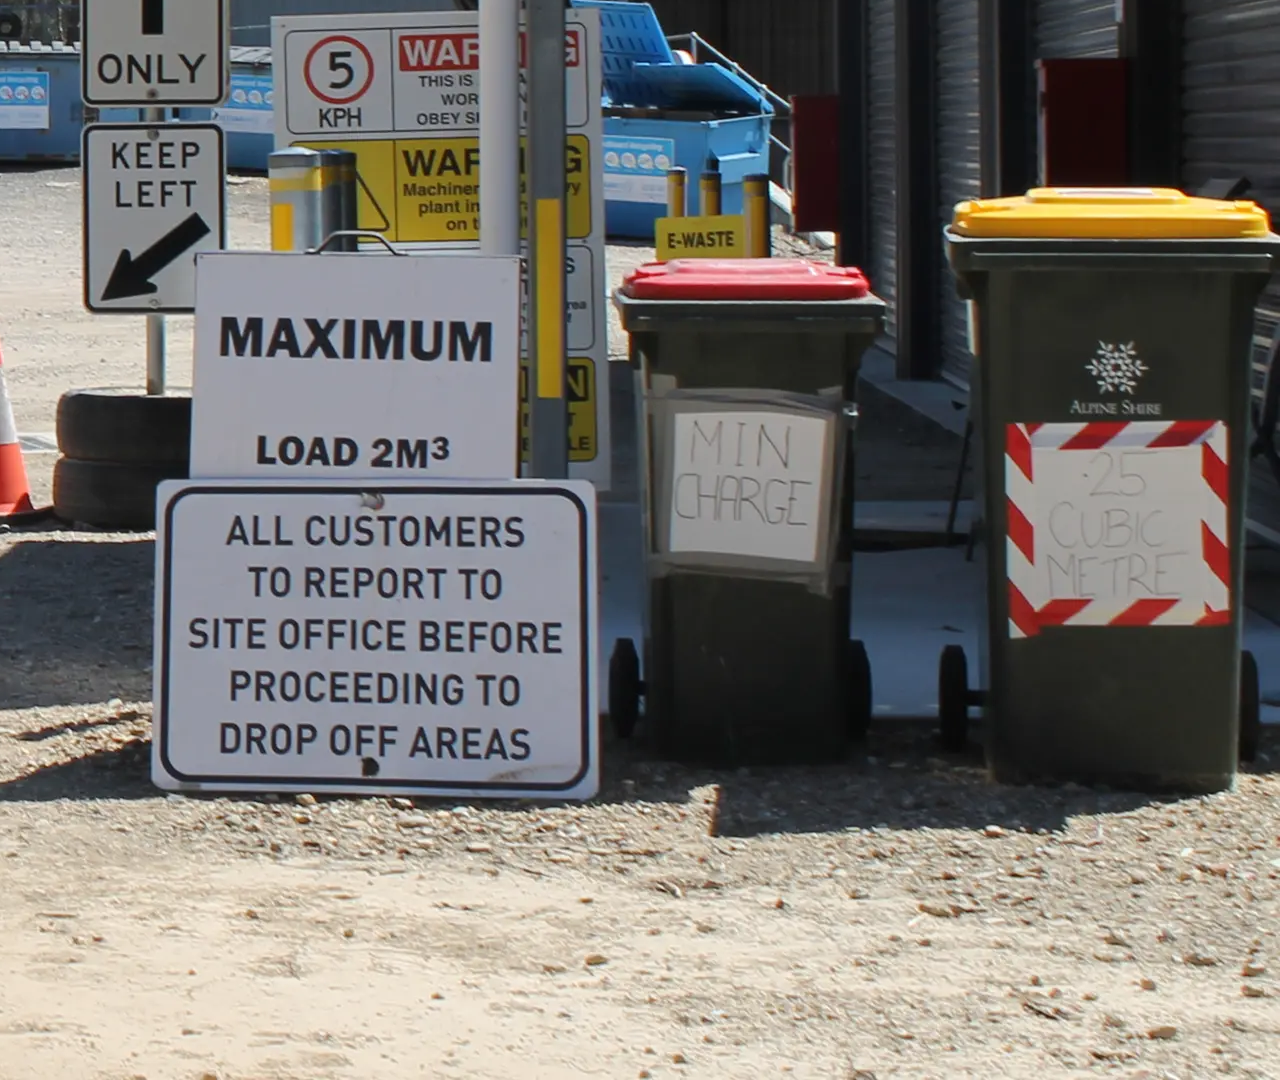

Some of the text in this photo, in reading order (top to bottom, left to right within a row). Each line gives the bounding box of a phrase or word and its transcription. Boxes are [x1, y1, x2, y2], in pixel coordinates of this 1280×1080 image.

[97, 53, 207, 84] ONLY
[329, 51, 354, 89] 5
[418, 73, 474, 87] THIS IS
[319, 108, 362, 127] KPH
[416, 112, 460, 125] OBEY
[112, 142, 200, 169] KEEP
[115, 181, 198, 207] LEFT
[403, 182, 480, 196] Machiner
[418, 200, 460, 217] plant
[446, 220, 467, 230] on
[667, 230, 735, 249] E-WASTE
[220, 317, 492, 362] MAXIMUM
[257, 435, 359, 466] LOAD
[691, 420, 790, 469] MIN
[674, 473, 812, 526] CHARGE
[226, 515, 525, 548] ALL CUSTOMERS
[1048, 501, 1164, 549] CUBIC
[248, 567, 502, 600] TO REPORT TO
[1046, 552, 1190, 598] METRE
[188, 618, 563, 653] SITE OFFICE BEFORE
[230, 671, 521, 707] PROCEEDING TO
[220, 722, 532, 761] DROP OFF AREAS
